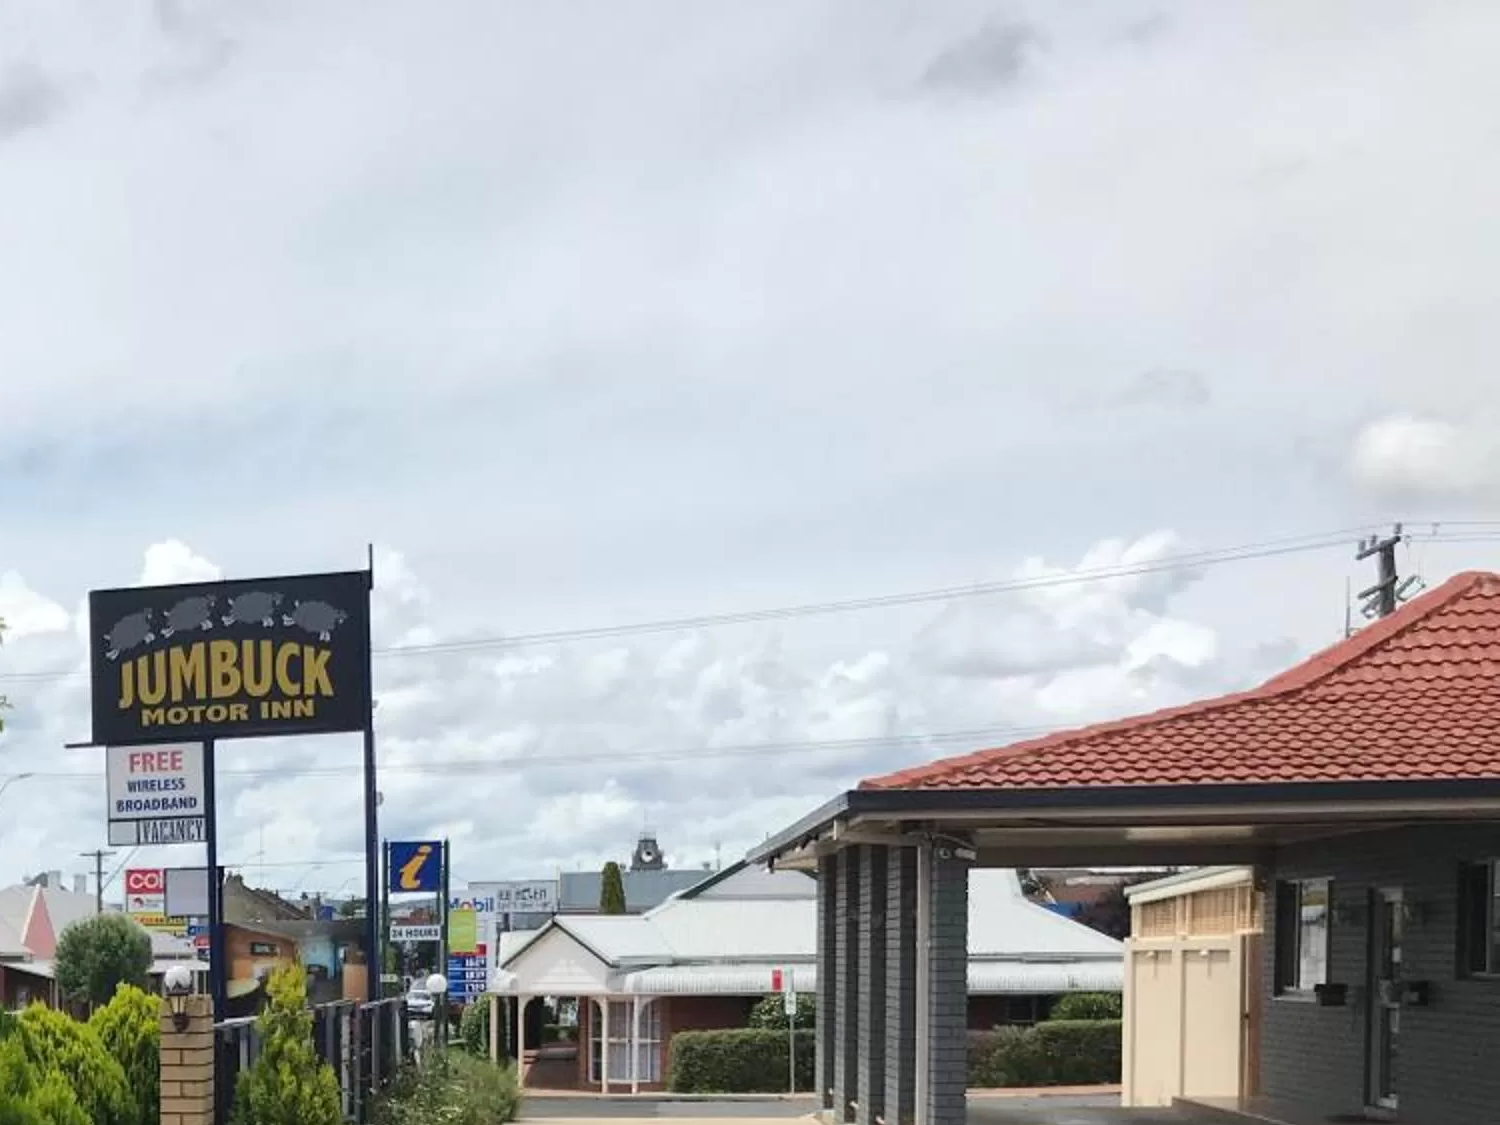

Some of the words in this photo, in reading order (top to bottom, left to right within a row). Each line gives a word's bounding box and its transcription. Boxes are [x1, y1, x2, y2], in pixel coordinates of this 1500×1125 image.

[118, 639, 334, 709] JUMBUCK
[141, 703, 249, 727] MOTOR
[261, 699, 315, 720] INN
[129, 750, 183, 773] FREE
[127, 778, 186, 793] WIRELESS
[116, 797, 198, 813] BROADBAND
[142, 819, 203, 843] VACANCY
[406, 927, 438, 938] HOURS
